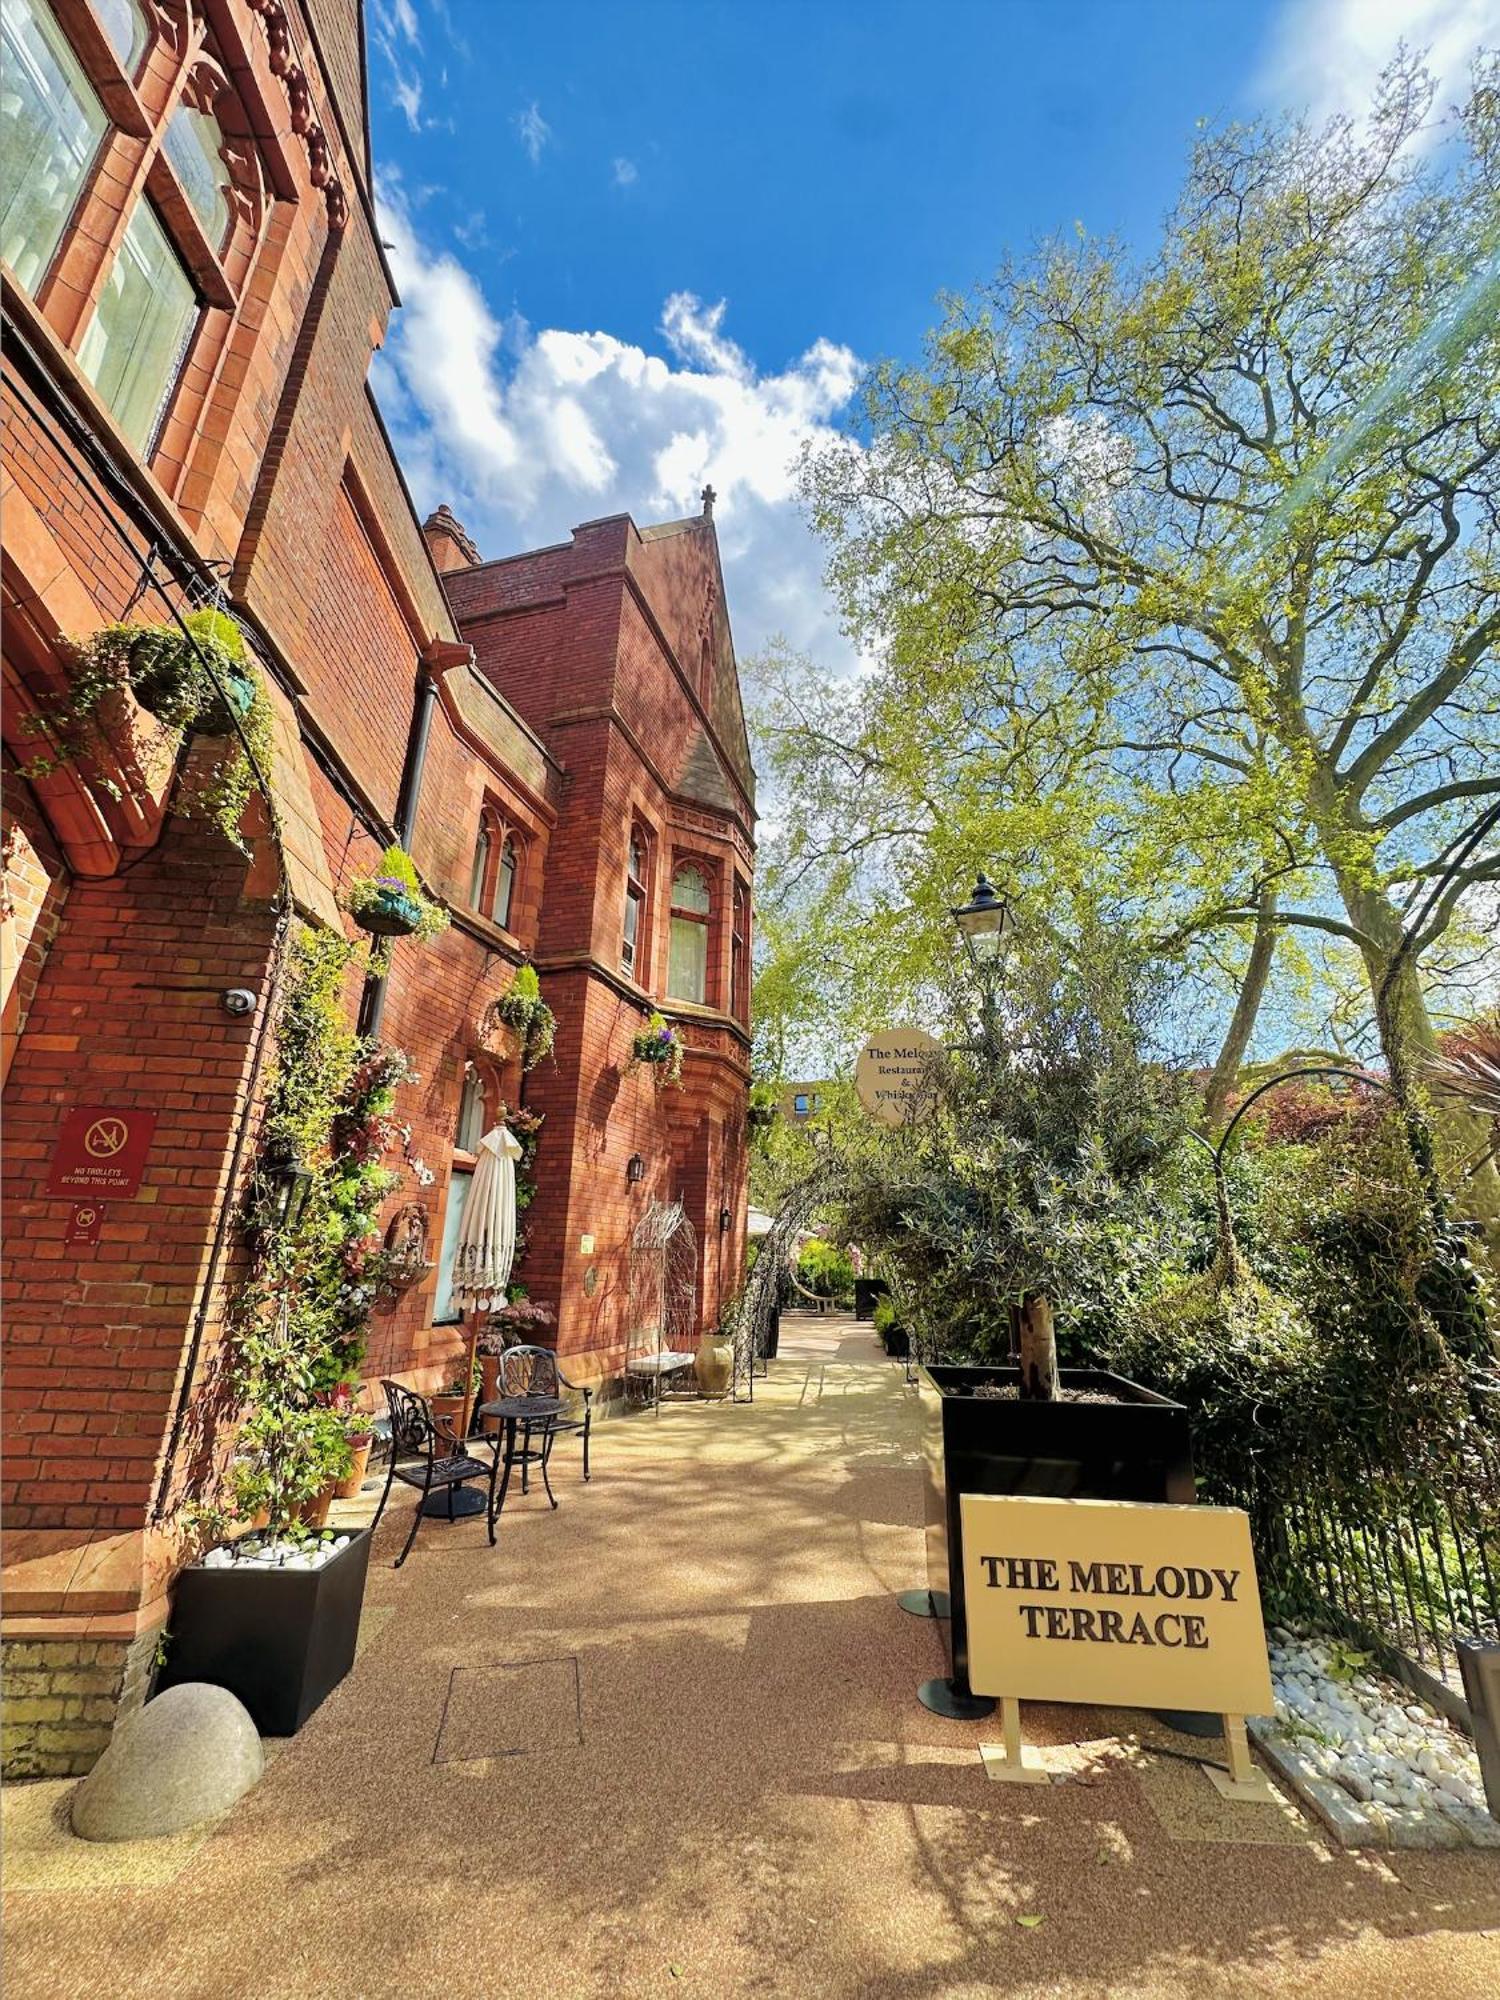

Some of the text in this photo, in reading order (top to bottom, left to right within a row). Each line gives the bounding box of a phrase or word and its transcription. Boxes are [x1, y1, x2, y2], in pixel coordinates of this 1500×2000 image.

[866, 1048, 891, 1059] The
[901, 1078, 911, 1087] &
[74, 1167, 121, 1177] NO TROLLEYS
[61, 1176, 129, 1186] BEYOND THIS POINT
[980, 1556, 1240, 1602] THE MELODY
[1019, 1605, 1209, 1649] TERRACE
